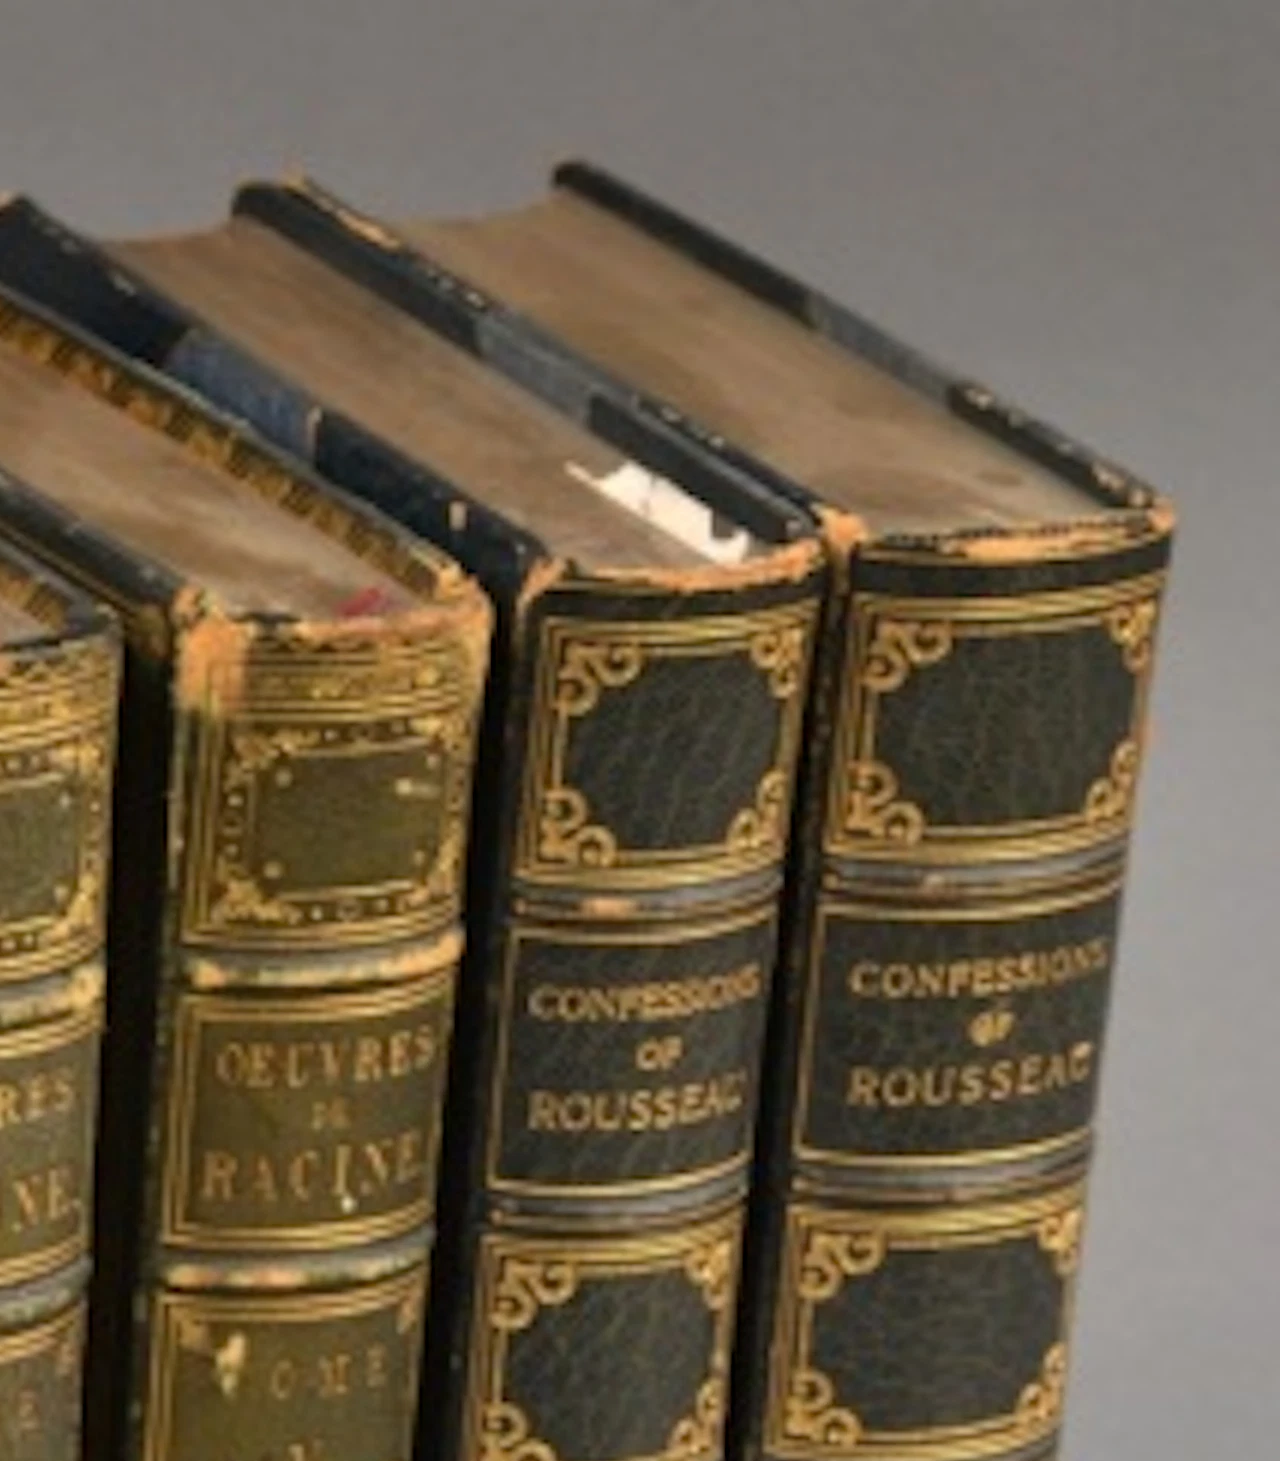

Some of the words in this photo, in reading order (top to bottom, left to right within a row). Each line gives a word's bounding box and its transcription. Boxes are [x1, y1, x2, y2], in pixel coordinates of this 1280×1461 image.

[527, 960, 761, 1022] CONFESSIONS
[848, 936, 1110, 998] CONFESSIONS
[635, 1035, 684, 1071] OF
[848, 1040, 1093, 1106] ROUSSEAU
[527, 1070, 747, 1130] ROUSSEAU
